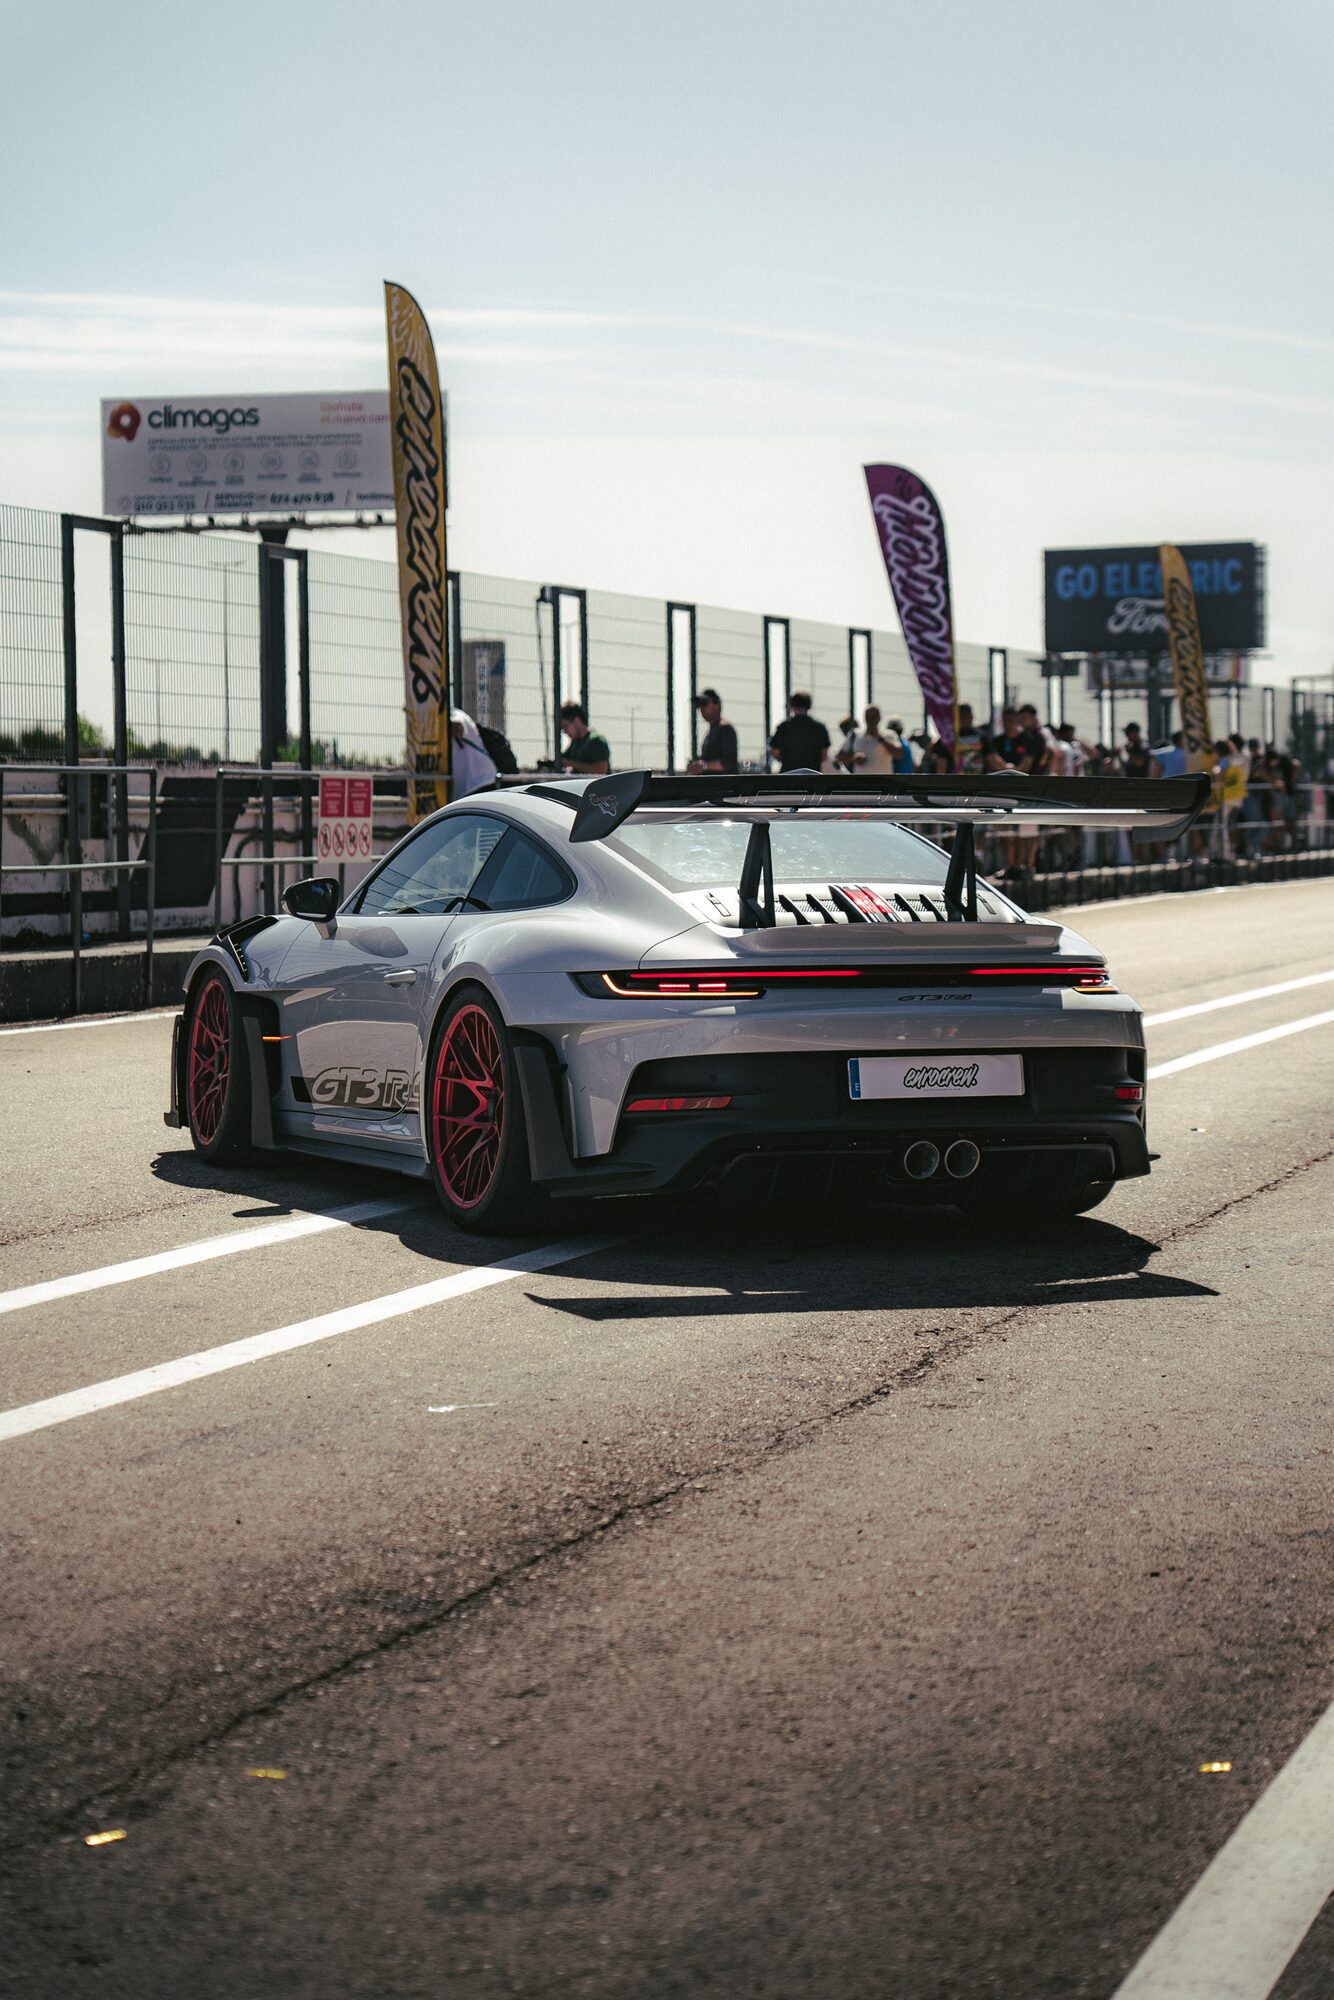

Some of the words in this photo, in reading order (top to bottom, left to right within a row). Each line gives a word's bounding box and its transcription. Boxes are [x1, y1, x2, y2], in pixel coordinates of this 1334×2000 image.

[1055, 565, 1099, 599] GO
[1104, 560, 1243, 598] ELERIC
[1106, 597, 1170, 634] For
